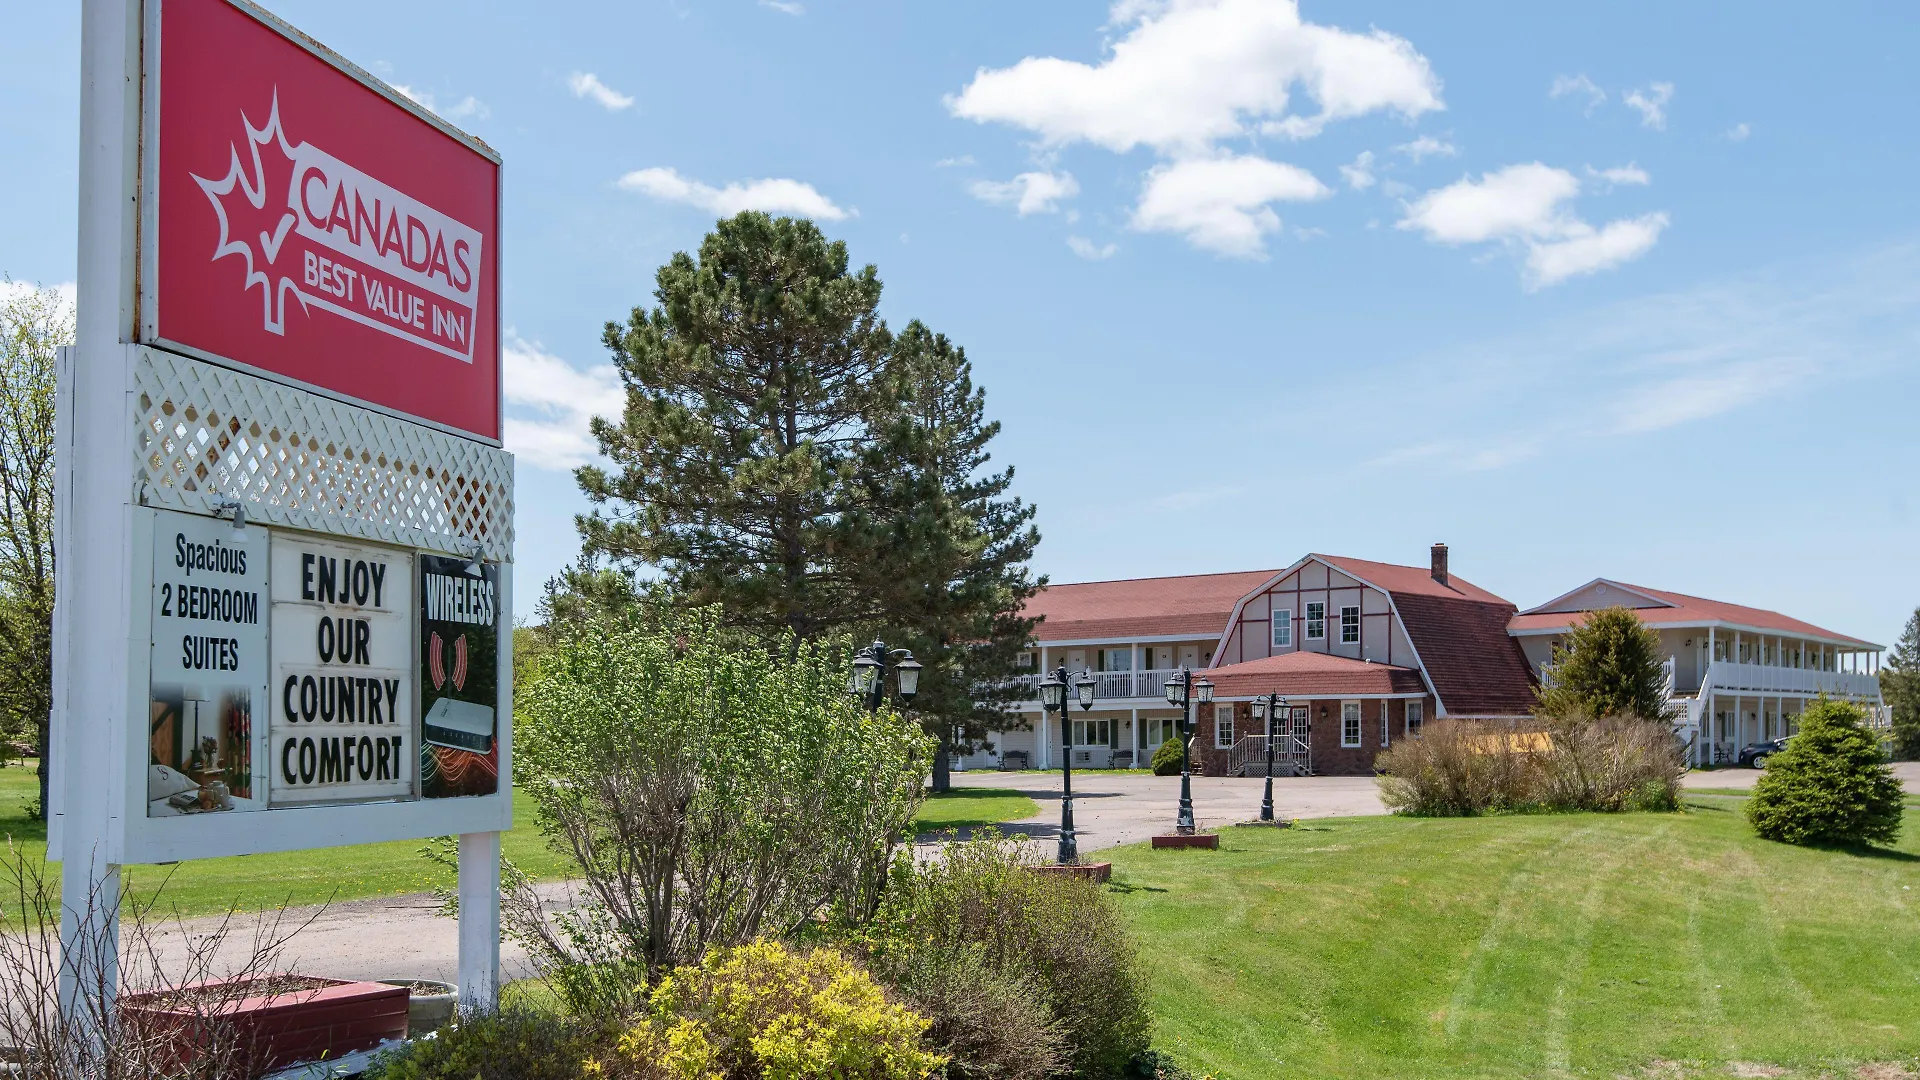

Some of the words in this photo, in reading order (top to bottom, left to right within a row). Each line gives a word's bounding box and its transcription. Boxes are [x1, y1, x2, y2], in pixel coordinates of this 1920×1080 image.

[300, 166, 472, 293] CANADAS
[304, 250, 357, 301] BEST
[361, 274, 424, 330] VALUE
[432, 304, 465, 346] INN
[175, 532, 247, 577] Spacious
[161, 582, 172, 617] 2
[178, 584, 258, 625] BEDROOM
[302, 553, 386, 607] ENJOY
[426, 573, 494, 627] WIRELESS
[182, 634, 239, 672] SUITES
[318, 616, 370, 665] OUR
[284, 674, 399, 725] COUNTRY
[282, 735, 402, 785] COMFORT
